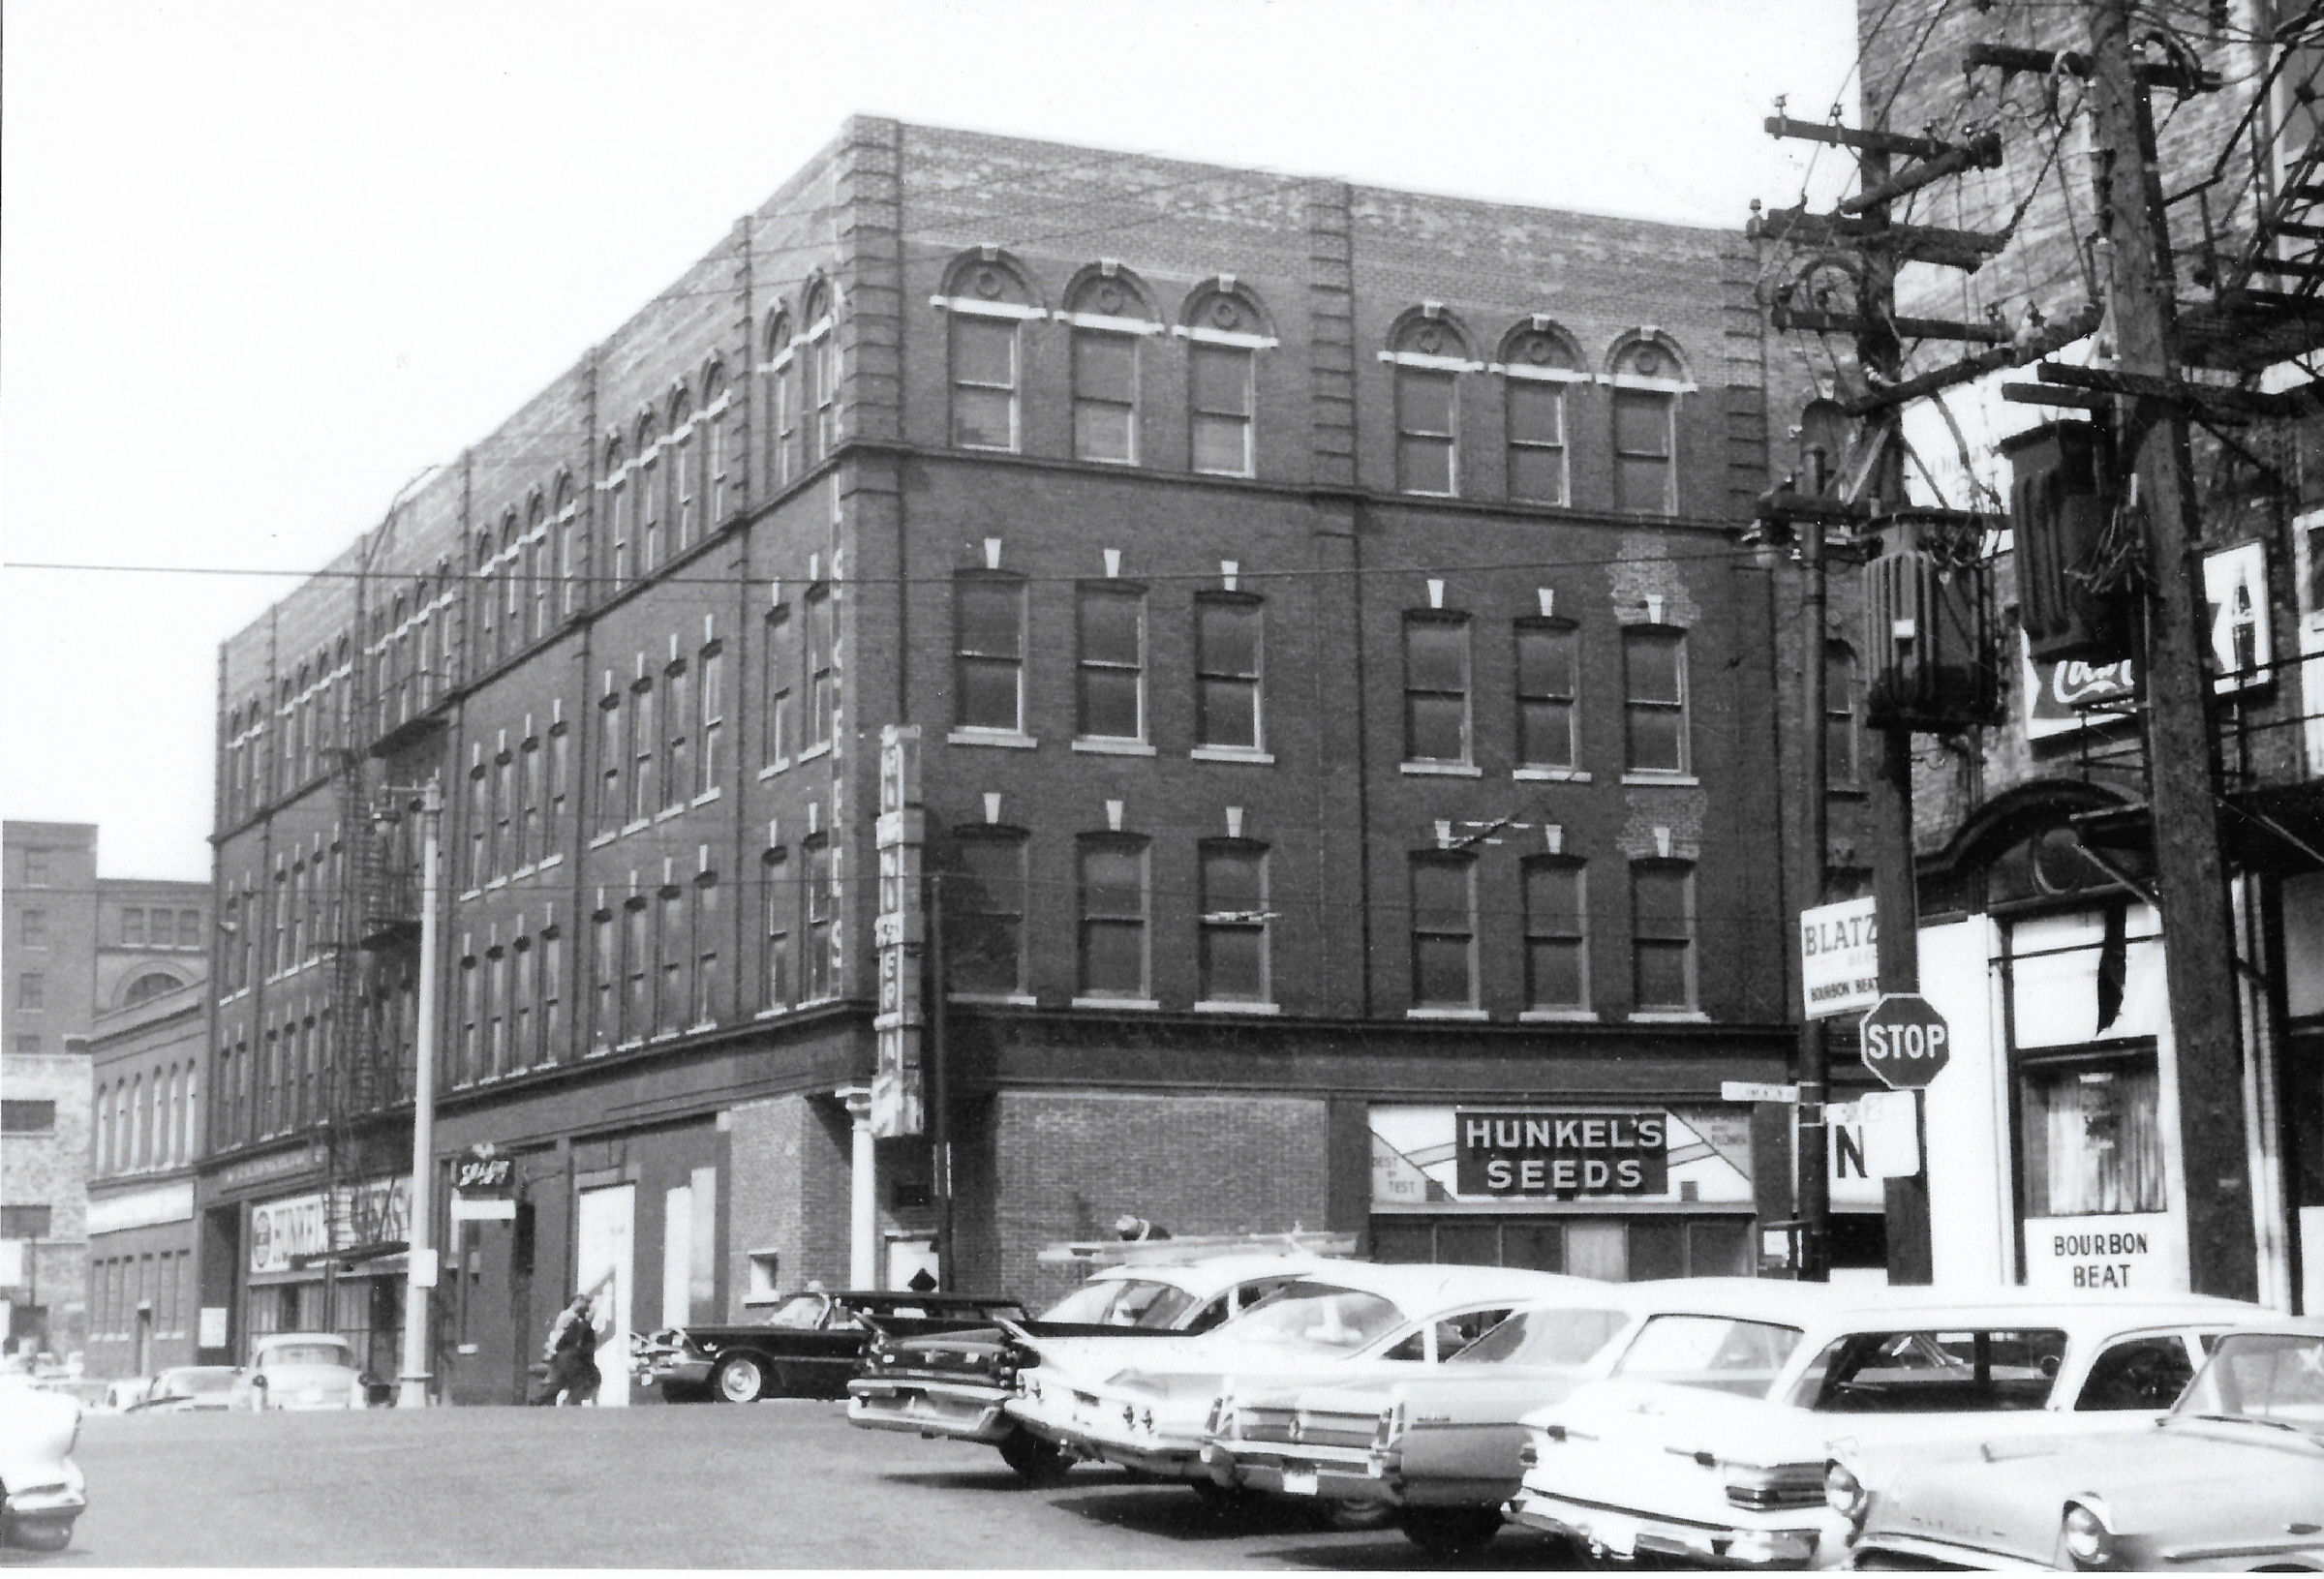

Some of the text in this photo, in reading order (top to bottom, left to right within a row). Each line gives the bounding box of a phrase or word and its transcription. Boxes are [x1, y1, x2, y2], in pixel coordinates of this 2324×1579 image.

[1804, 913, 1878, 957] BLATZ
[1868, 1023, 1945, 1060] STOP
[1466, 1118, 1664, 1148] HUNKEL'S
[1389, 1180, 1416, 1194] TEST
[1487, 1160, 1643, 1189] SEEDS
[2054, 1232, 2149, 1257] BOURBON
[2073, 1264, 2131, 1288] BEAT
